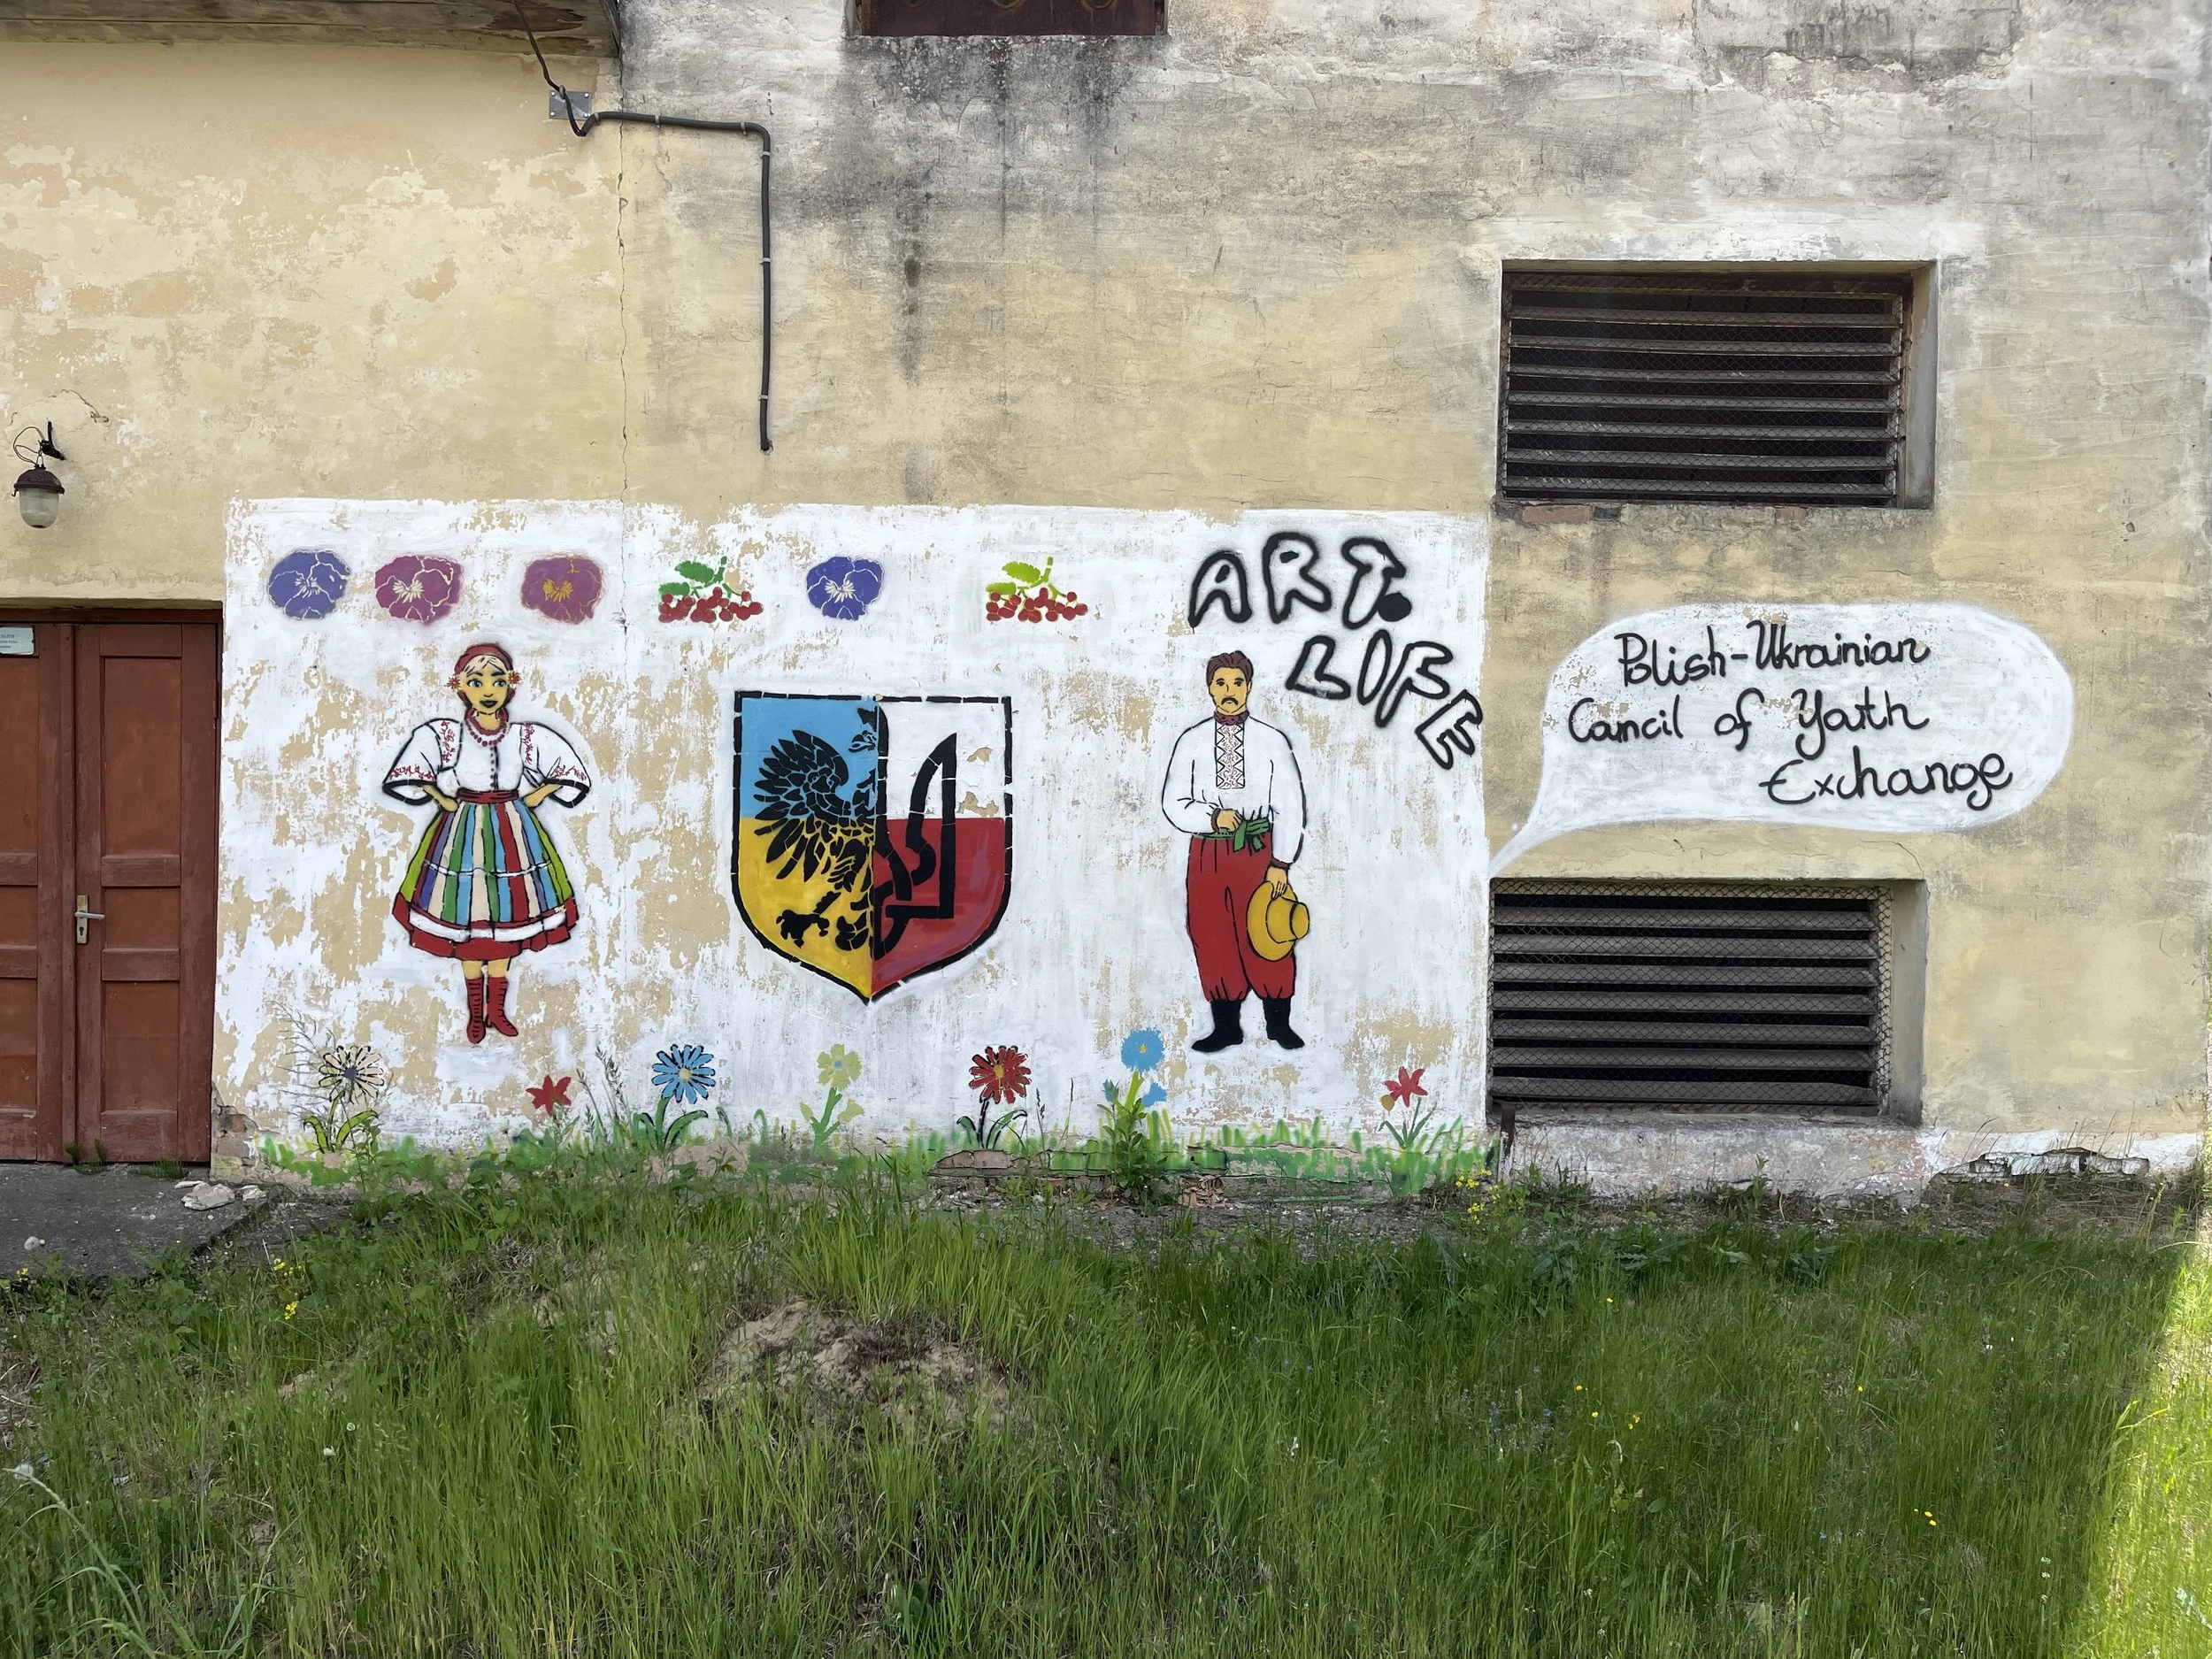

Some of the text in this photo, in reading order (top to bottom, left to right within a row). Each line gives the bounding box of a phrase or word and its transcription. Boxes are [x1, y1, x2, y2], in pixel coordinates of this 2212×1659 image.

[1614, 619, 1931, 687] Polish-Ukrainian
[1286, 629, 1483, 771] LIFE
[1714, 687, 1765, 751] of
[1758, 745, 2013, 810] Exchange
